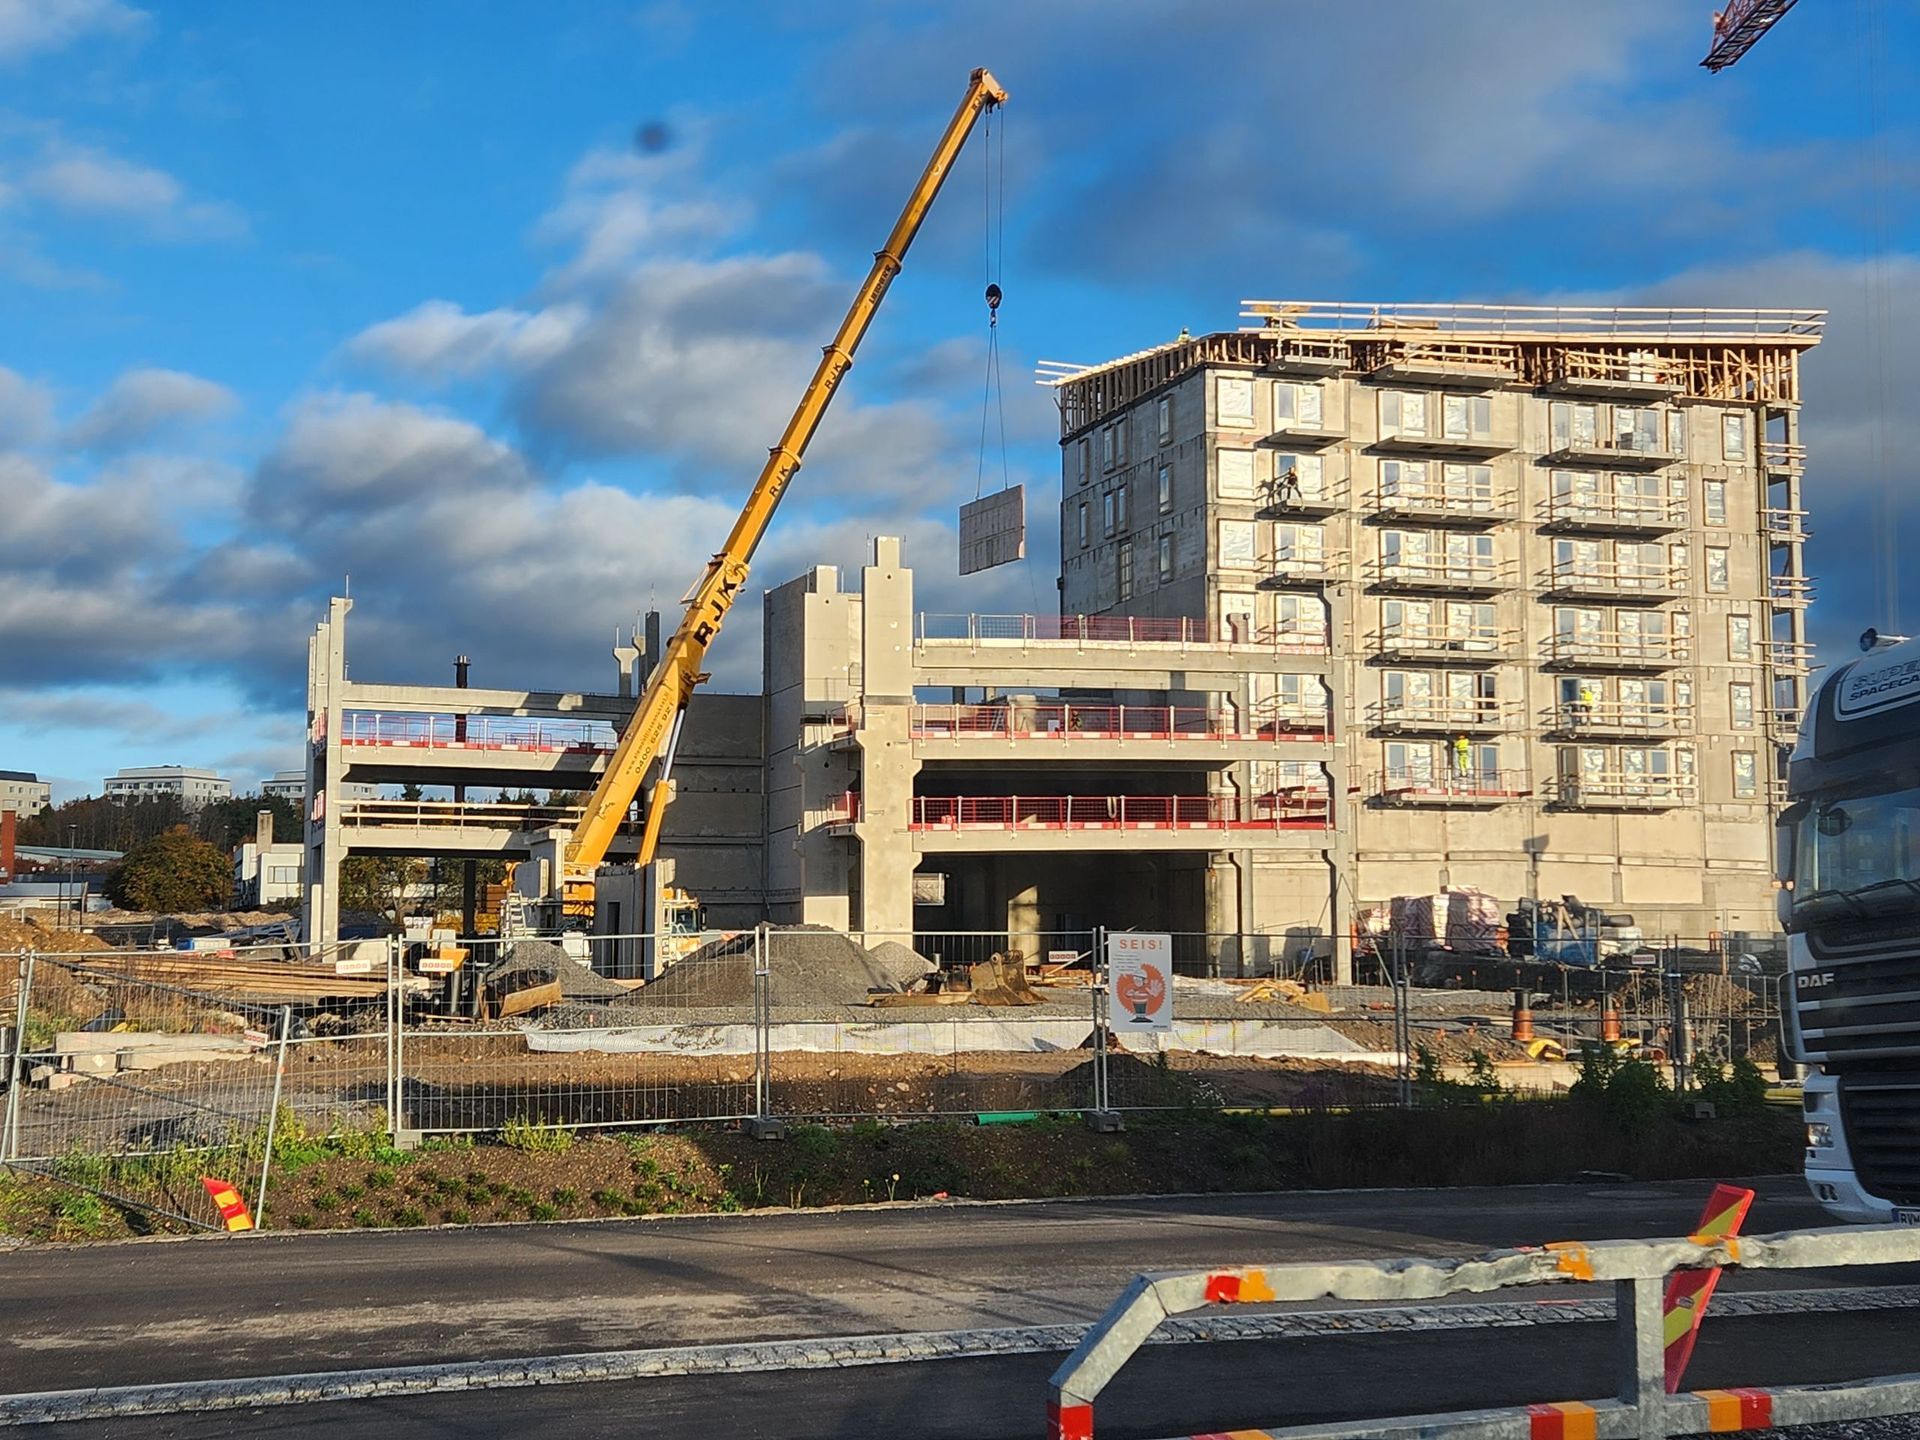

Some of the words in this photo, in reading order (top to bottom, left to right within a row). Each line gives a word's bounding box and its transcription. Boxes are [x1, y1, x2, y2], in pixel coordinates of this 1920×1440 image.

[824, 362, 842, 390] RJK
[769, 465, 789, 498] RJK
[692, 574, 738, 648] RJK
[1852, 657, 1920, 691] SUPE
[1798, 973, 1834, 989] DAF
